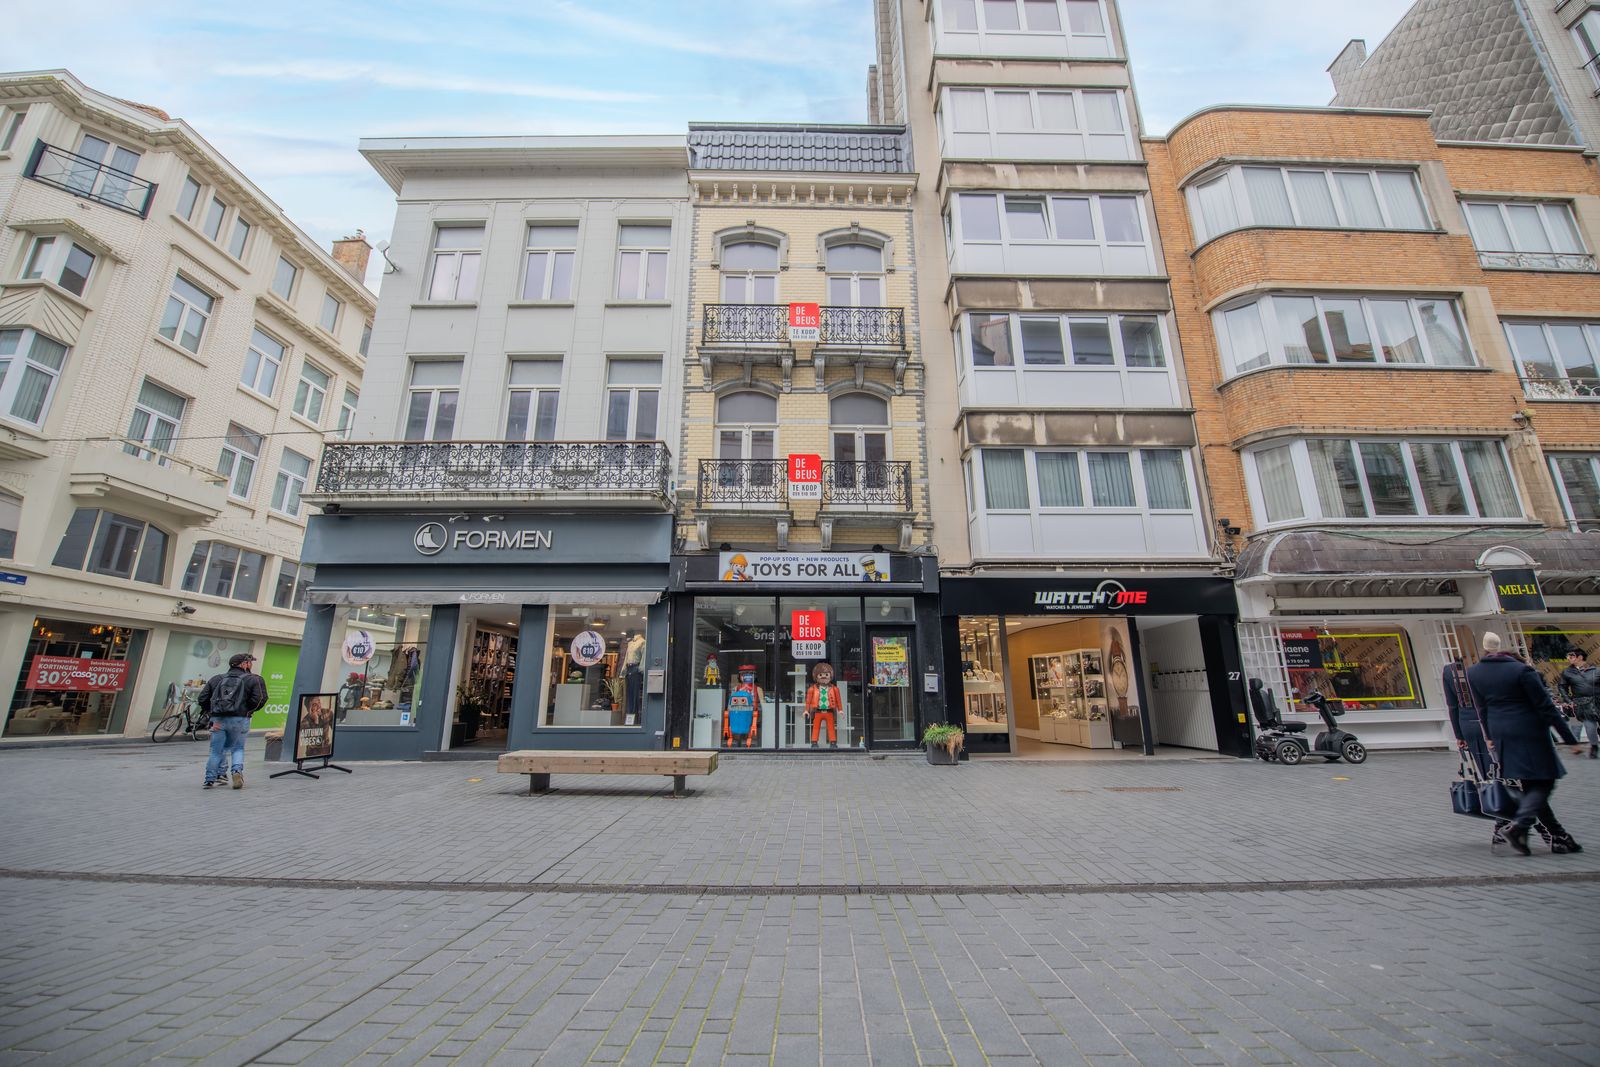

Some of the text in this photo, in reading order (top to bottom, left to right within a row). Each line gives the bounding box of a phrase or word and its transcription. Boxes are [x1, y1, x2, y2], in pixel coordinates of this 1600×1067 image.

[795, 306, 806, 315] DE
[795, 316, 816, 325] BEUS
[795, 458, 806, 468] DE
[795, 470, 817, 480] BEUS
[453, 530, 552, 549] FORMEN
[751, 563, 860, 577] TOYS FOR ALL
[1498, 584, 1538, 596] MEI-LI
[799, 615, 810, 626] DE
[799, 627, 822, 638] BEUS
[1282, 642, 1310, 652] iaene
[38, 663, 78, 671] KORTINGEN
[36, 670, 72, 685] 30%
[88, 673, 119, 687] 30%
[1228, 671, 1241, 680] 27
[264, 704, 290, 714] casa
[301, 728, 324, 737] AUTUMN
